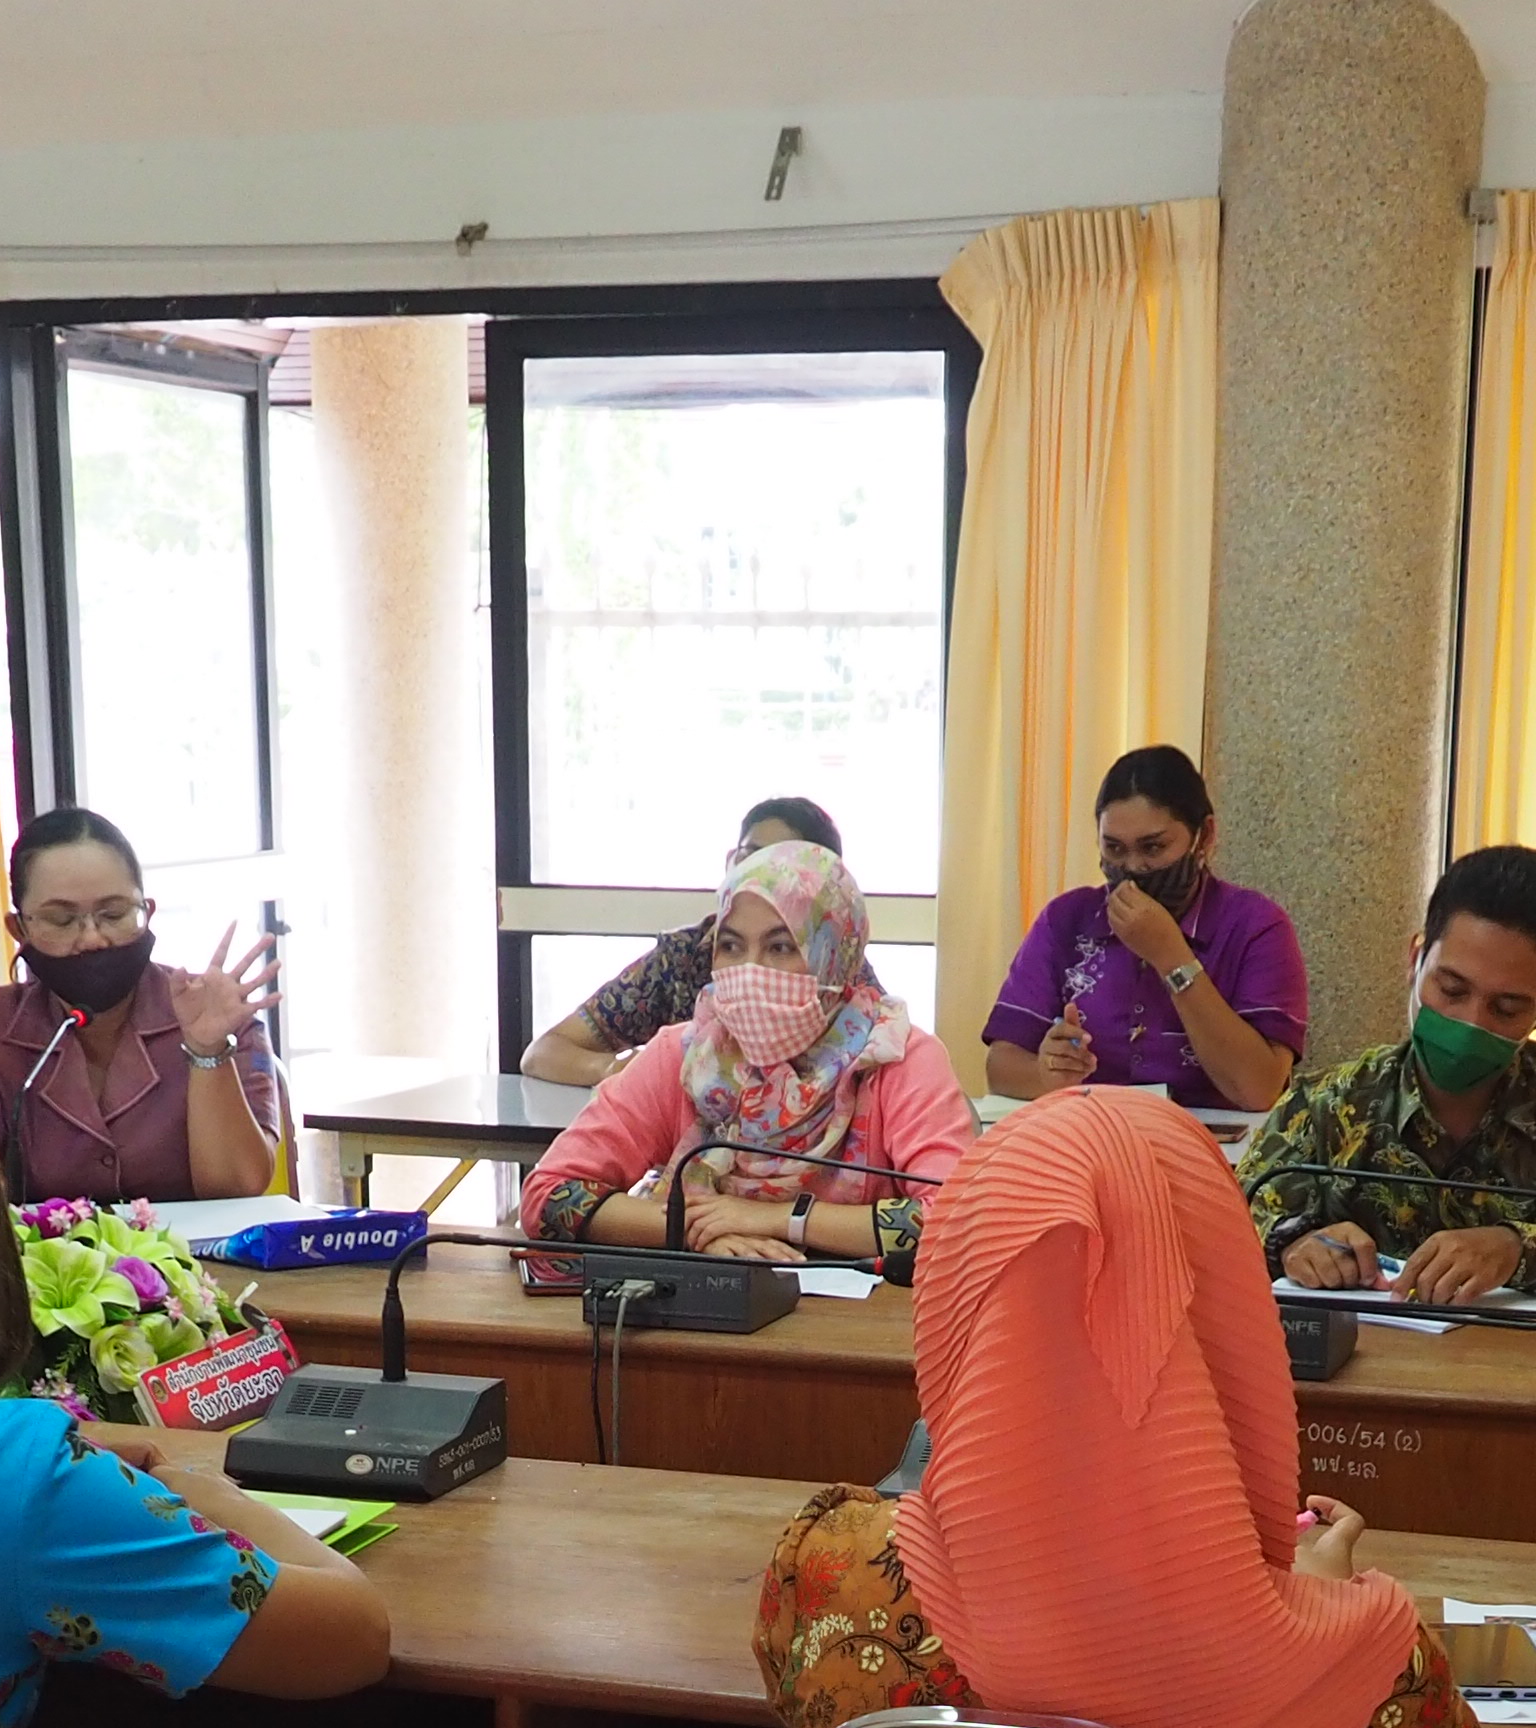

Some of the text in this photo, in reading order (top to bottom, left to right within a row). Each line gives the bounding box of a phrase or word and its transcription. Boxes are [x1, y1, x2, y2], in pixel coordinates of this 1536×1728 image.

[300, 1229, 397, 1253] Double A
[166, 1334, 279, 1393] สำนักงานพัฒนาชุมชน
[187, 1366, 285, 1424] จังหวัดยะลา
[1394, 1429, 1422, 1452] (2)
[375, 1456, 420, 1472] NPE
